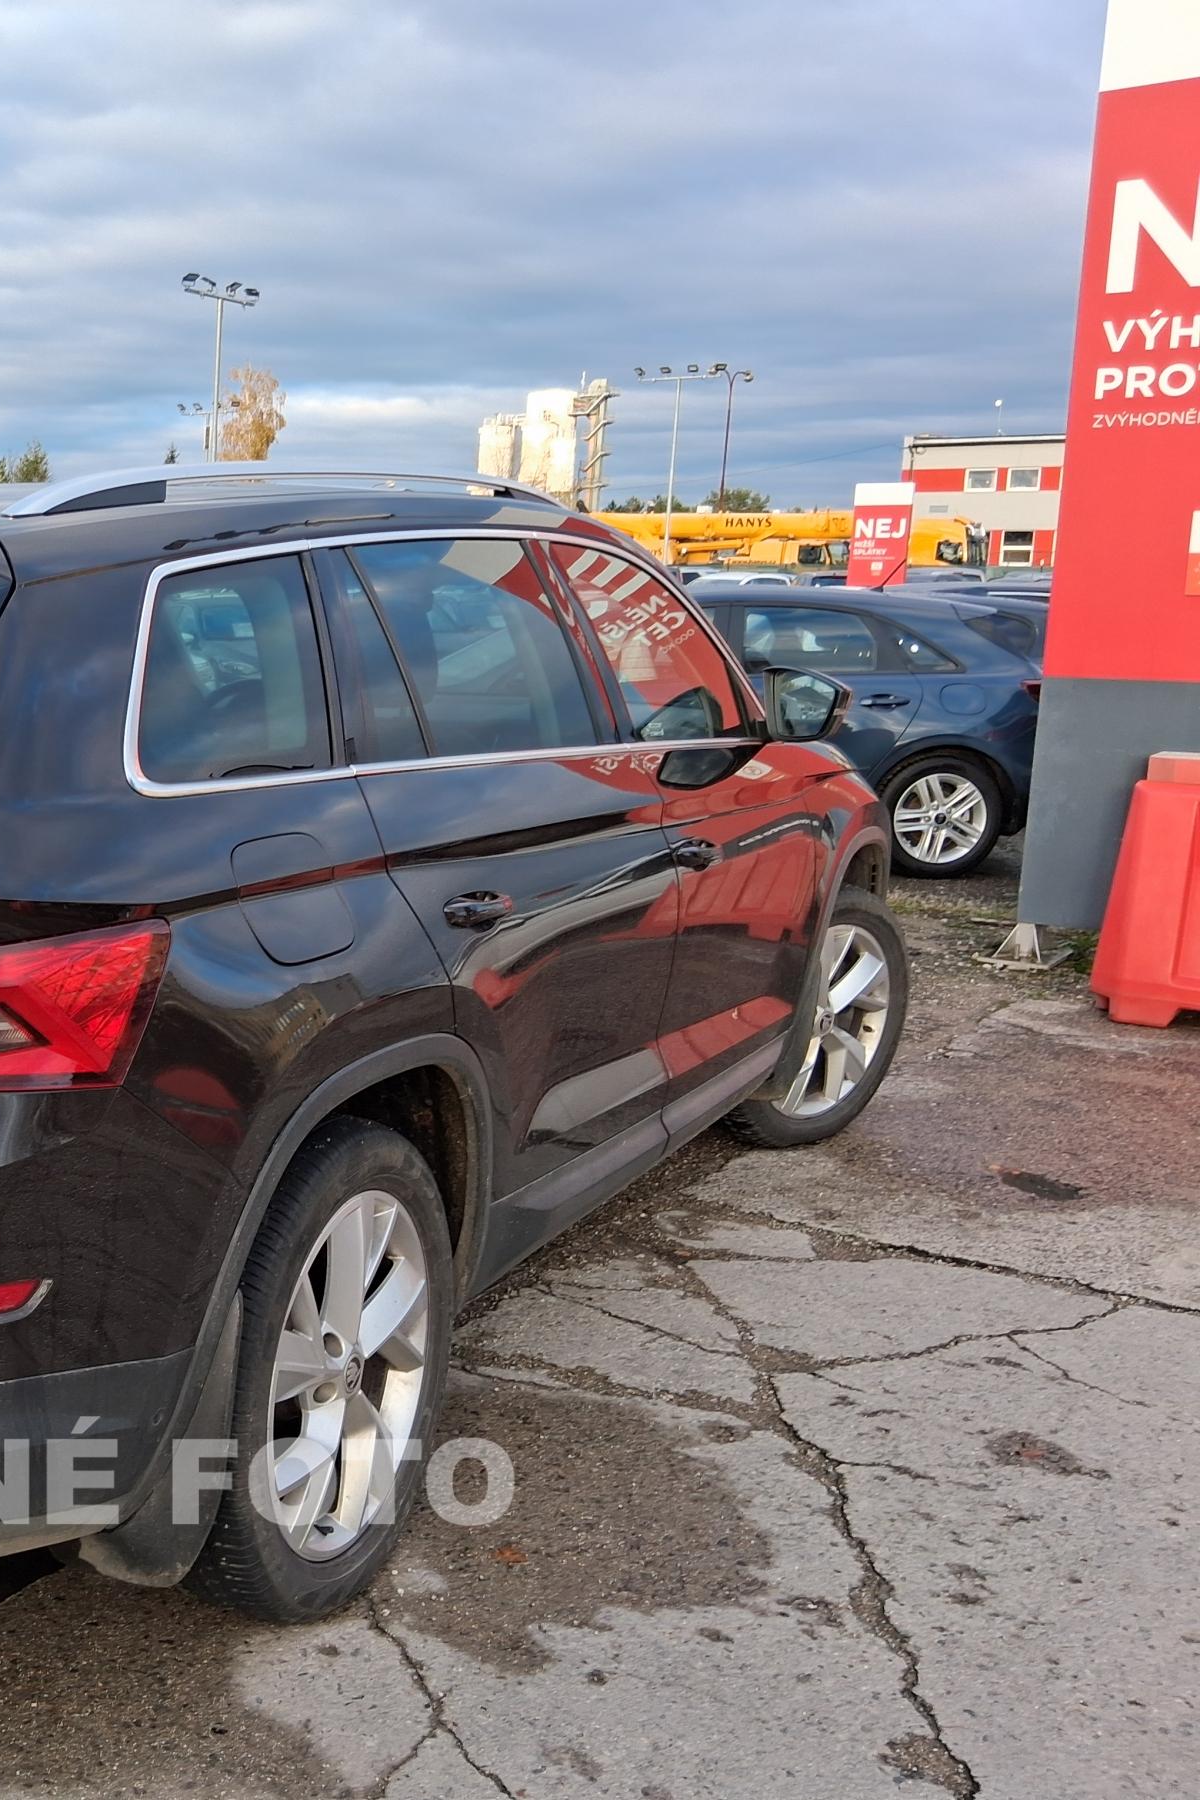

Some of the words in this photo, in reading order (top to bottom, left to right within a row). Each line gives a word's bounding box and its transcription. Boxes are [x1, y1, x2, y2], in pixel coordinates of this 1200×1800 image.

[1103, 309, 1200, 353] VÝH
[1094, 362, 1200, 400] PRO
[1092, 408, 1200, 428] ZVÝHODNĚ
[725, 517, 772, 527] HANYS
[854, 518, 907, 538] NEJ
